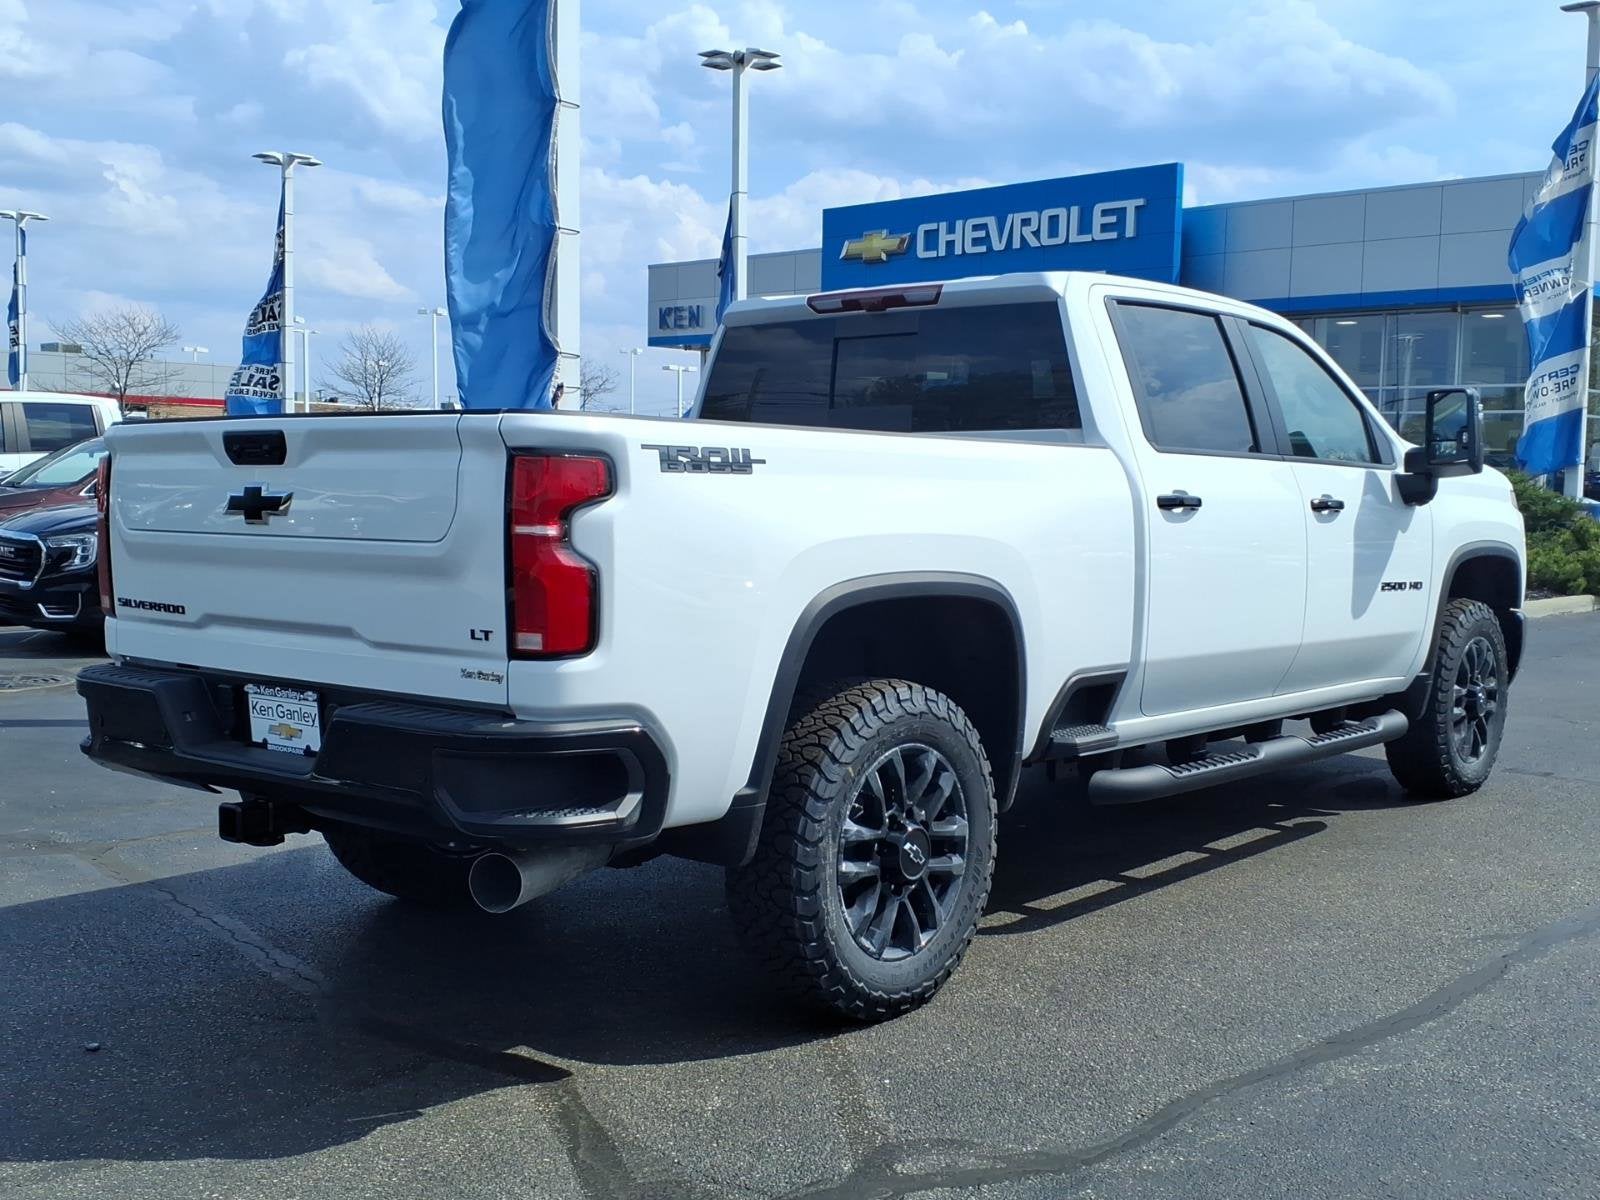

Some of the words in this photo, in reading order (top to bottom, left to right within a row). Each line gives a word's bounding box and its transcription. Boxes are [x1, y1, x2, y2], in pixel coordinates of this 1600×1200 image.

[916, 198, 1147, 259] CHEVROLET
[658, 304, 702, 330] KEN
[641, 444, 766, 464] TRAIL
[660, 460, 753, 475] BOSS
[1381, 581, 1407, 592] 2500
[1408, 581, 1423, 590] HD
[117, 596, 186, 615] SILVERADO
[470, 628, 494, 642] LT
[259, 685, 276, 697] Ken
[274, 687, 300, 702] Ganley
[250, 699, 275, 718] Ken
[275, 703, 317, 728] Ganley
